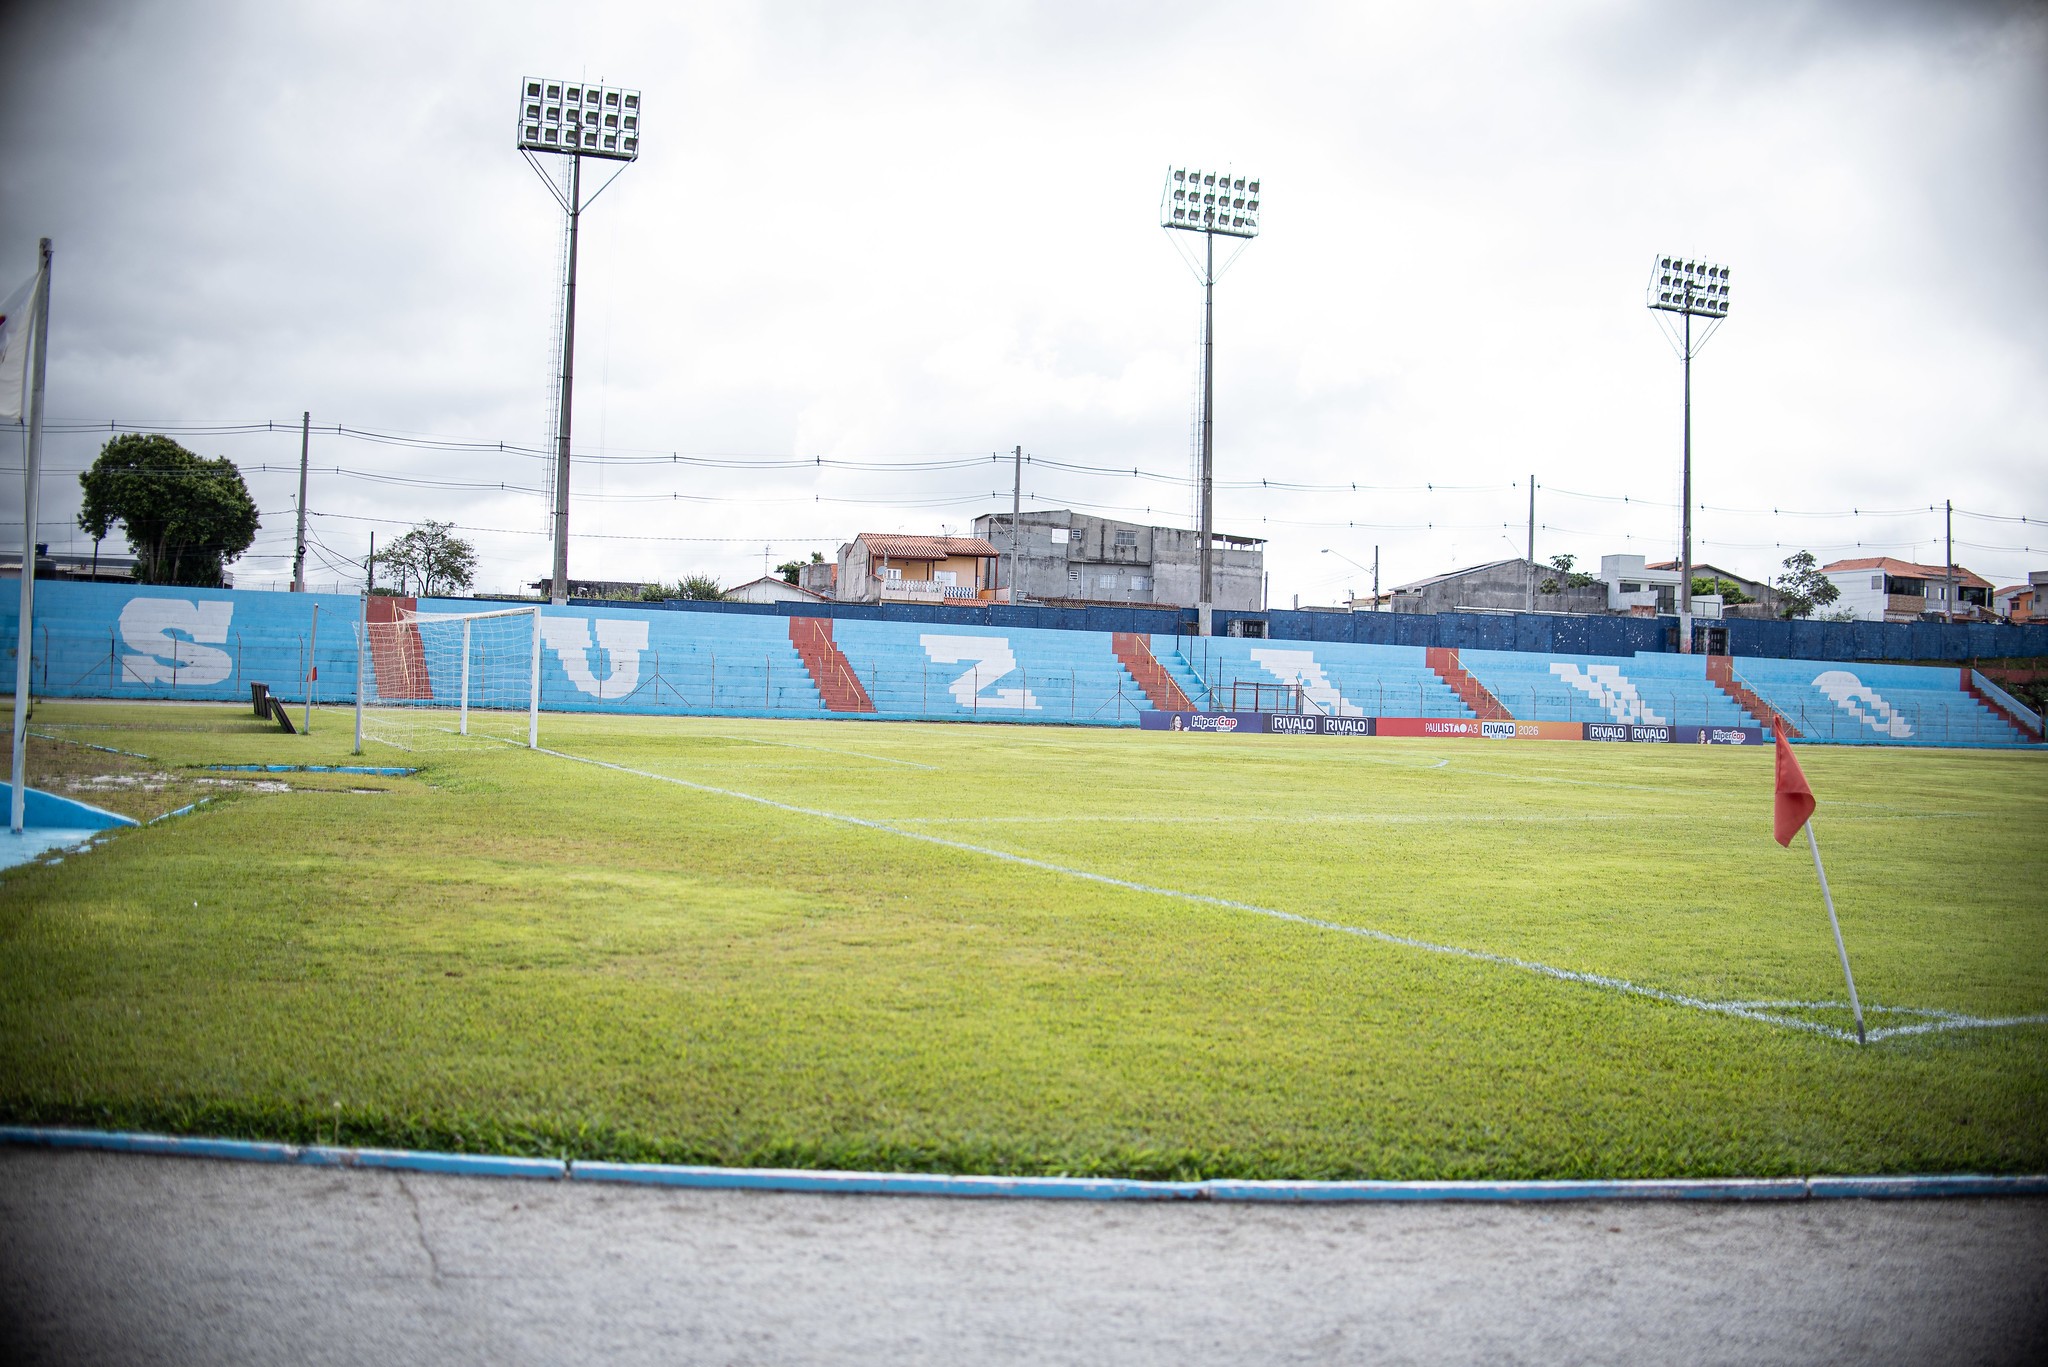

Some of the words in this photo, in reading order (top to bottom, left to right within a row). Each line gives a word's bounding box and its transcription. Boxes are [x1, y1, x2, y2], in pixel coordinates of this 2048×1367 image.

[1192, 715, 1238, 729] HiperCap
[1274, 717, 1314, 729] RIVALO
[1326, 719, 1366, 732] RIVALO
[1467, 724, 1479, 733] A3
[1483, 724, 1514, 734] RIVALO
[1518, 725, 1539, 735] 2026
[1591, 727, 1624, 738] RIVALO
[1633, 729, 1667, 740] RIVALO
